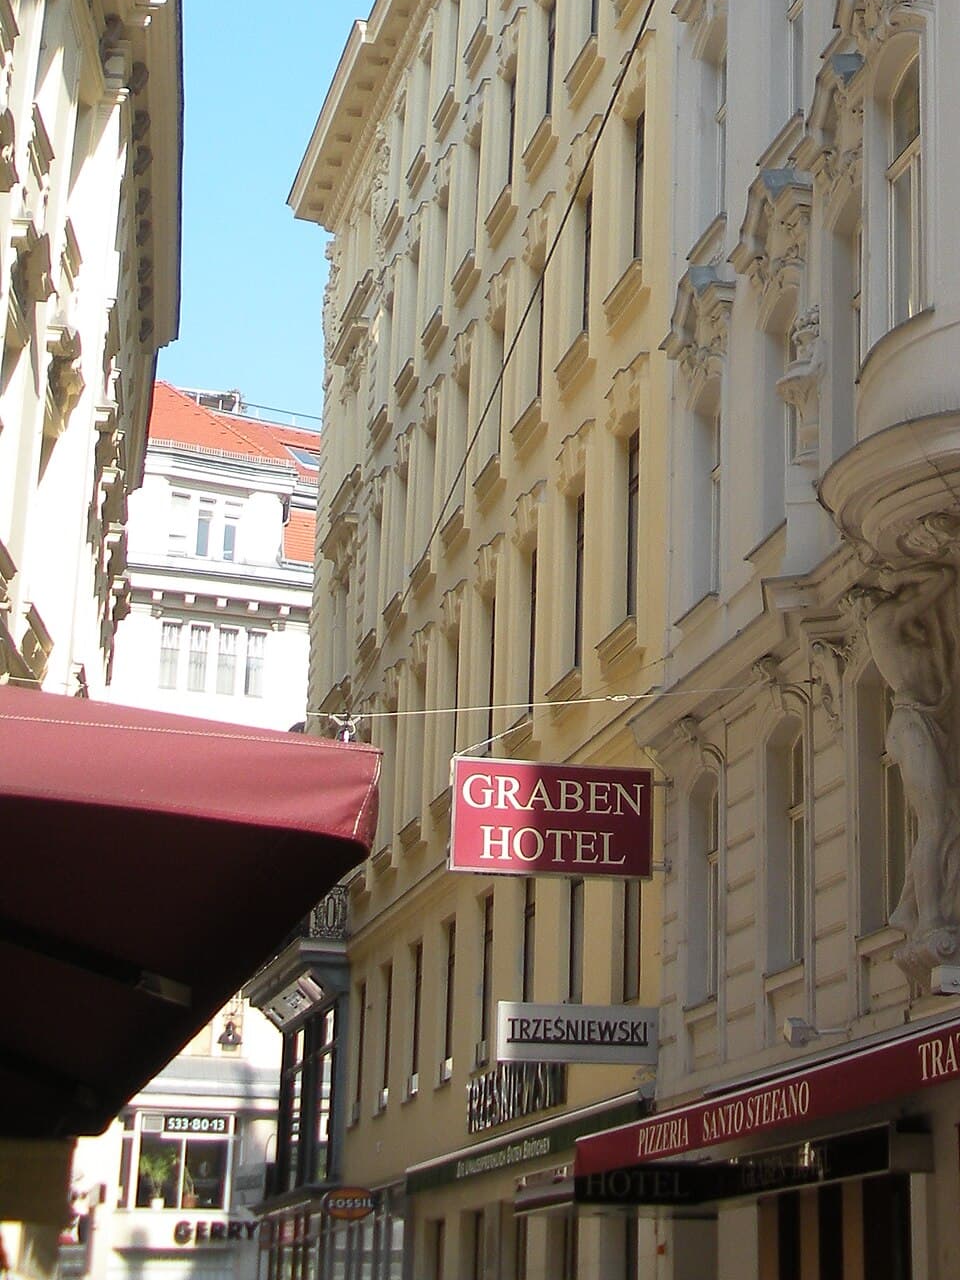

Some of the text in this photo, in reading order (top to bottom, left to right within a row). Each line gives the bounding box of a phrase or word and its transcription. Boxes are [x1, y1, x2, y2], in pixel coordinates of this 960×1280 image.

[462, 773, 645, 816] GRABEN
[479, 825, 627, 865] HOTEL
[637, 1080, 810, 1157] PIZZERIA SANTO STEFANO
[328, 1197, 374, 1209] FOSSIL
[173, 1219, 259, 1246] GERRY
